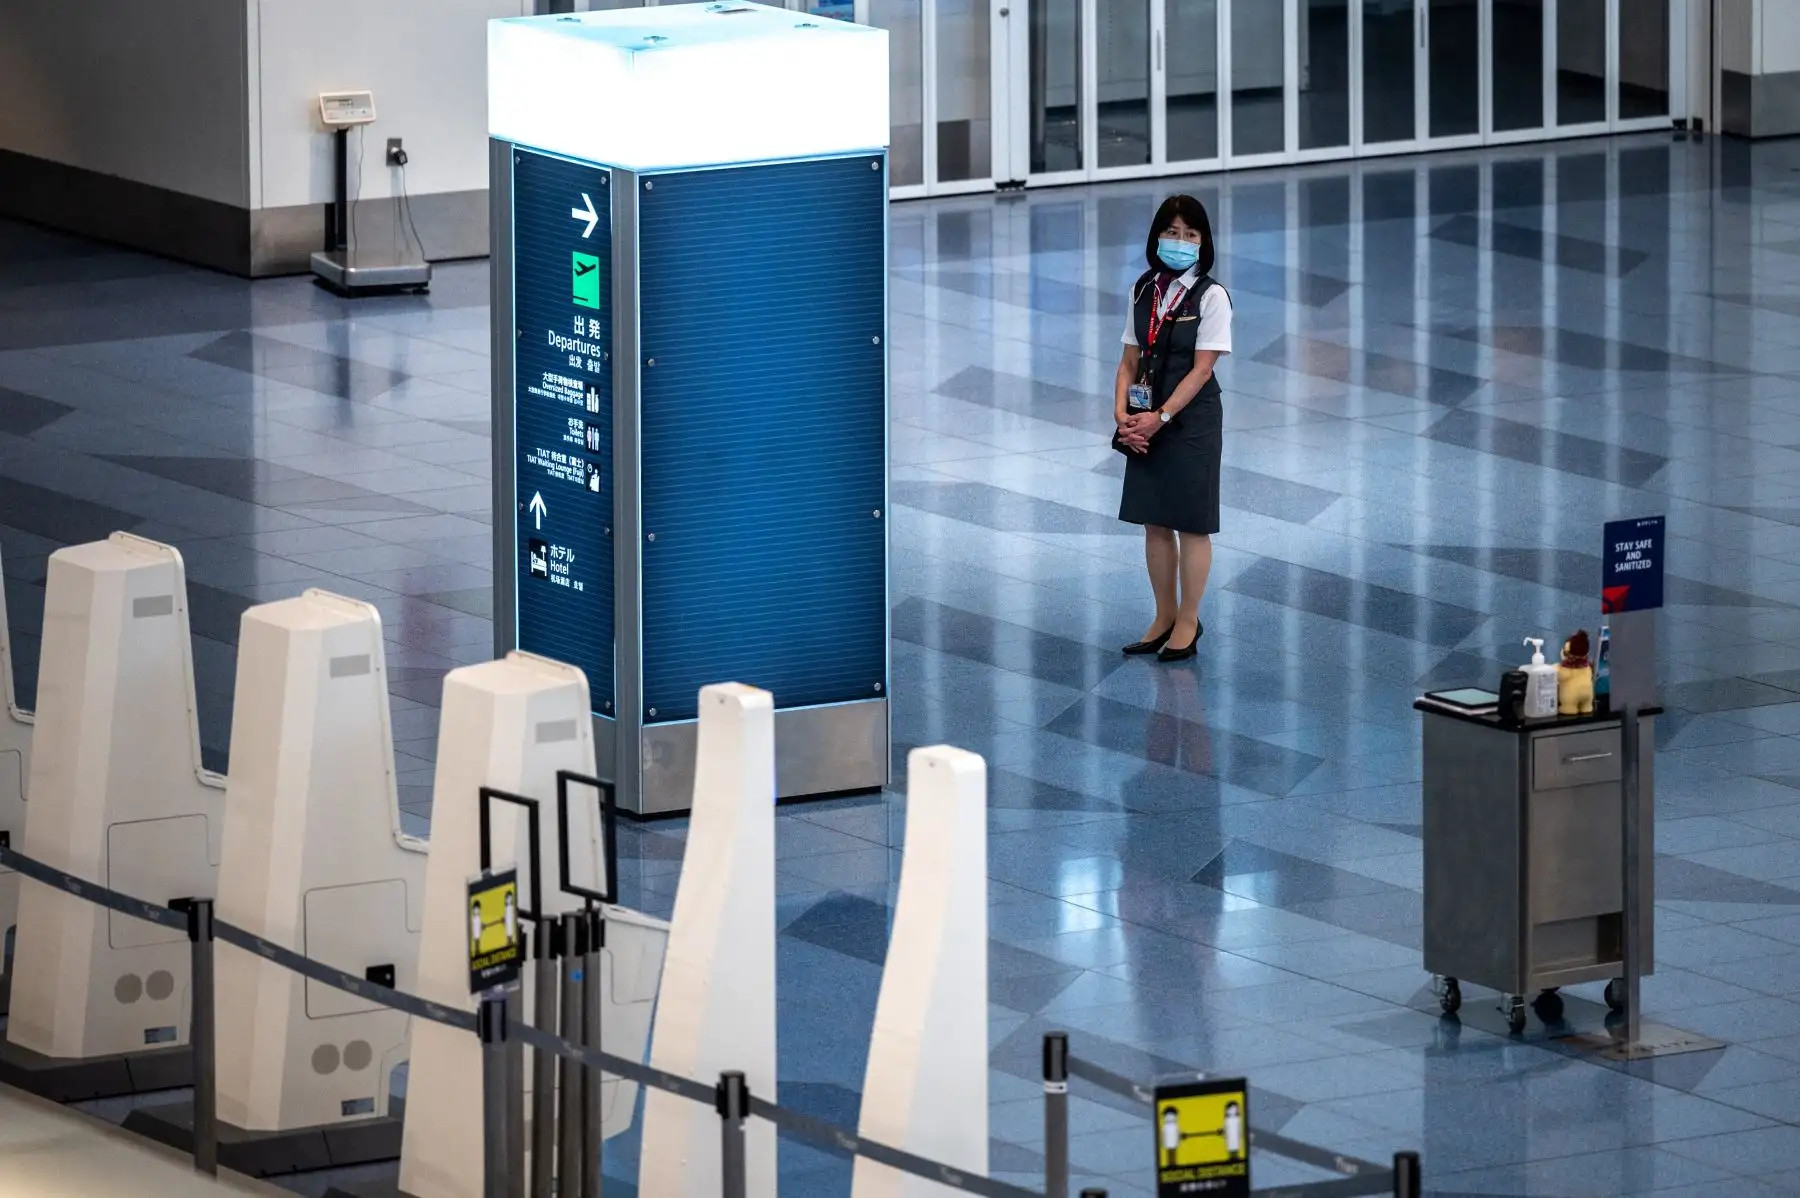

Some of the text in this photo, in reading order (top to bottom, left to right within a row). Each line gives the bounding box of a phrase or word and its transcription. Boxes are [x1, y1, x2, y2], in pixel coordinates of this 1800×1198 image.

[574, 315, 601, 339] 出発
[548, 329, 601, 357] Departures
[542, 381, 564, 393] Oversized
[538, 457, 555, 469] Waiting
[555, 463, 572, 473] Lounge
[1615, 538, 1652, 552] STAY SAFE
[550, 544, 575, 563] ホテル
[1626, 551, 1641, 560] AND
[550, 559, 569, 575] Hotel
[1615, 559, 1652, 572] SANITIZED
